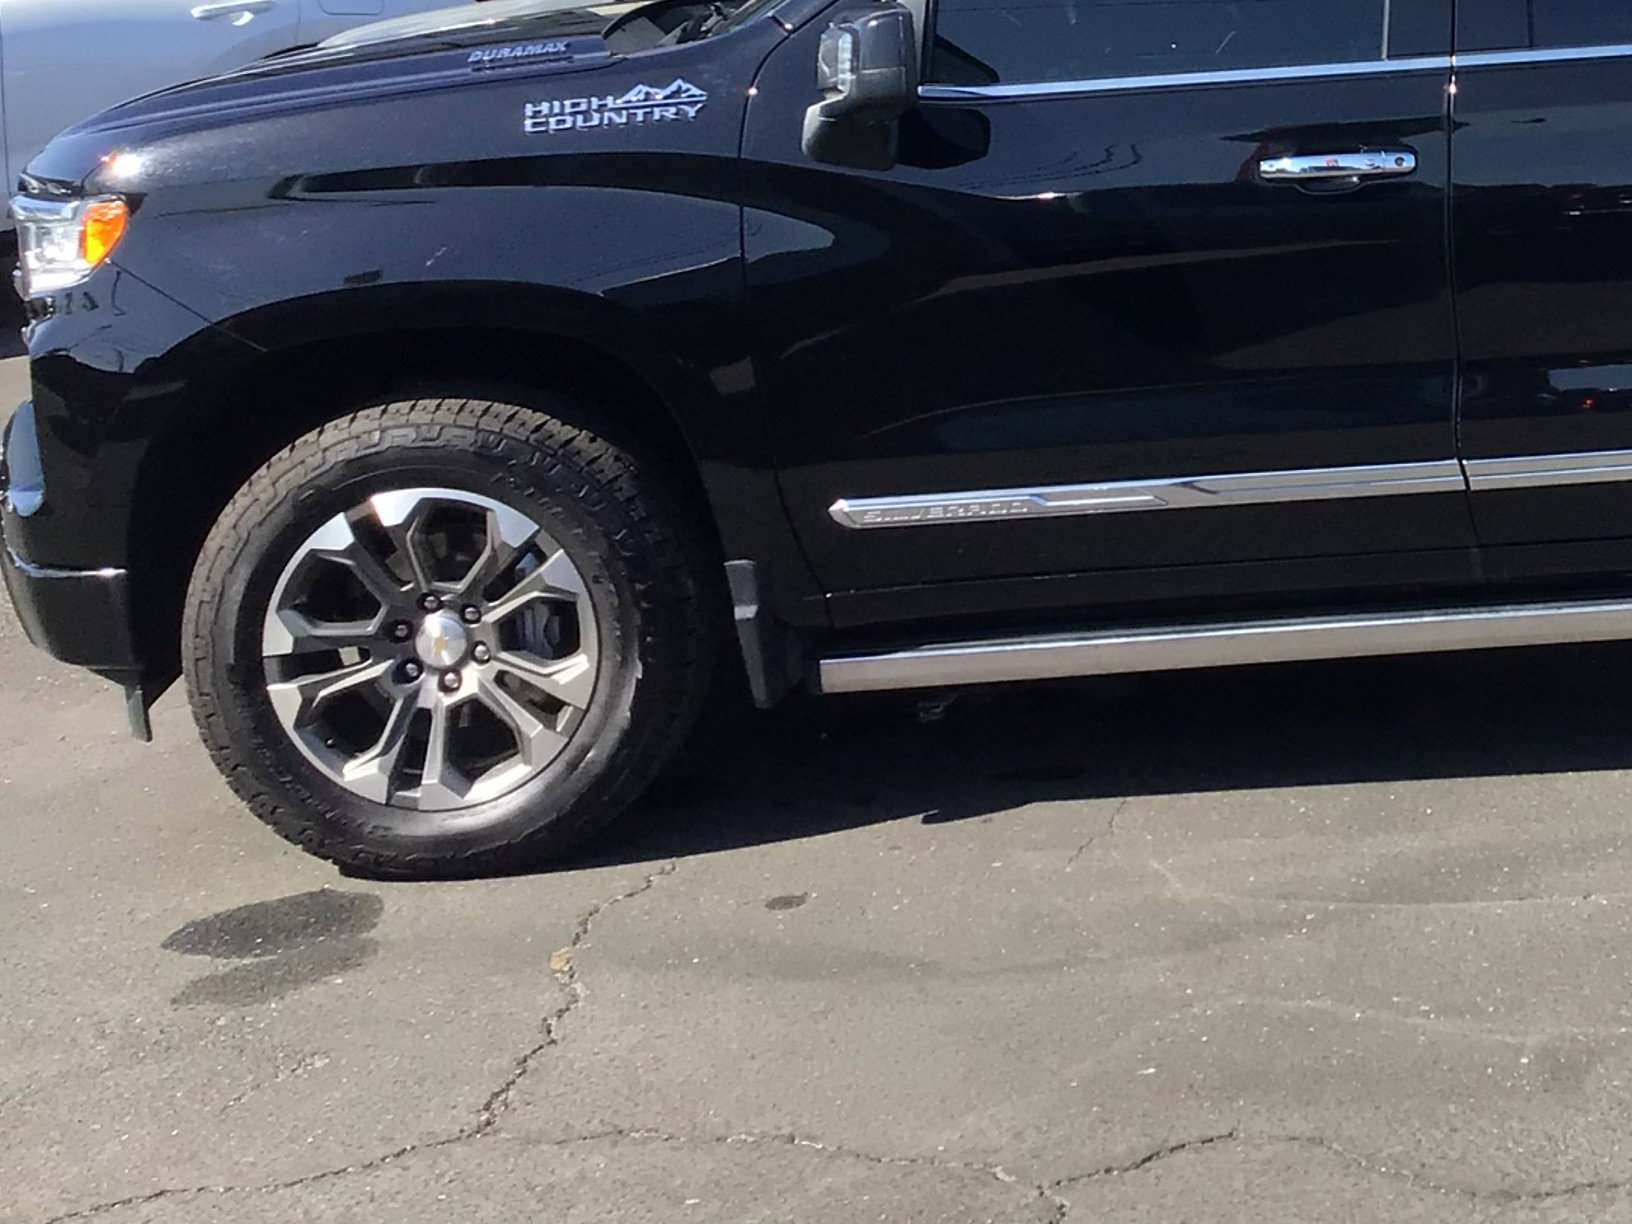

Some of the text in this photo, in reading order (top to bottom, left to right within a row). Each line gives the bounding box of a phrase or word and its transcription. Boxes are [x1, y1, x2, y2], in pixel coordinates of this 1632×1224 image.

[467, 40, 569, 63] DURAMAX
[524, 95, 617, 117] HIGH
[523, 103, 705, 134] COUNTRY
